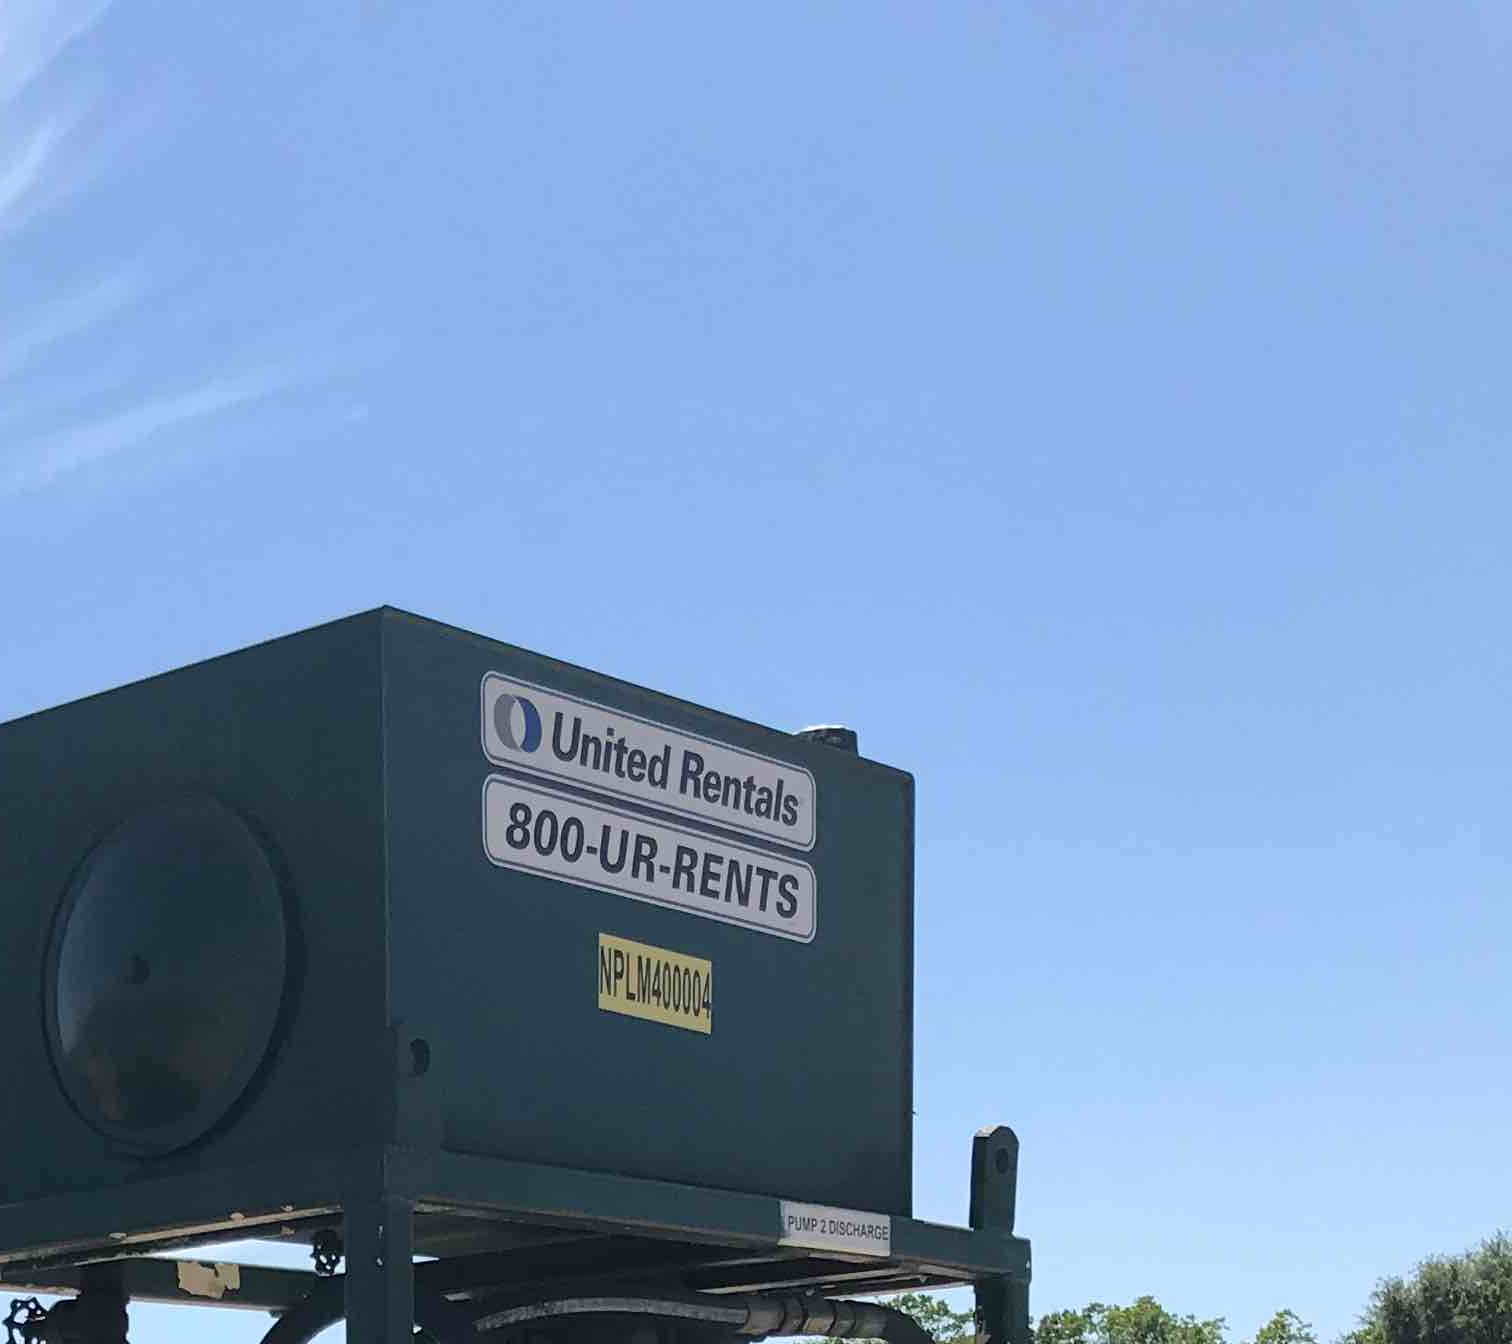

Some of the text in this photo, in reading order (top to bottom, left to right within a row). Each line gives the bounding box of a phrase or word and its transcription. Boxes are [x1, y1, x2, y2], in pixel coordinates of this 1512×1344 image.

[552, 711, 799, 827] United Rentals
[505, 802, 800, 919] 800-UR-RENTS
[599, 945, 711, 1019] NPLM400004
[788, 1215, 889, 1241] PUMP 2 DISCHARGE
